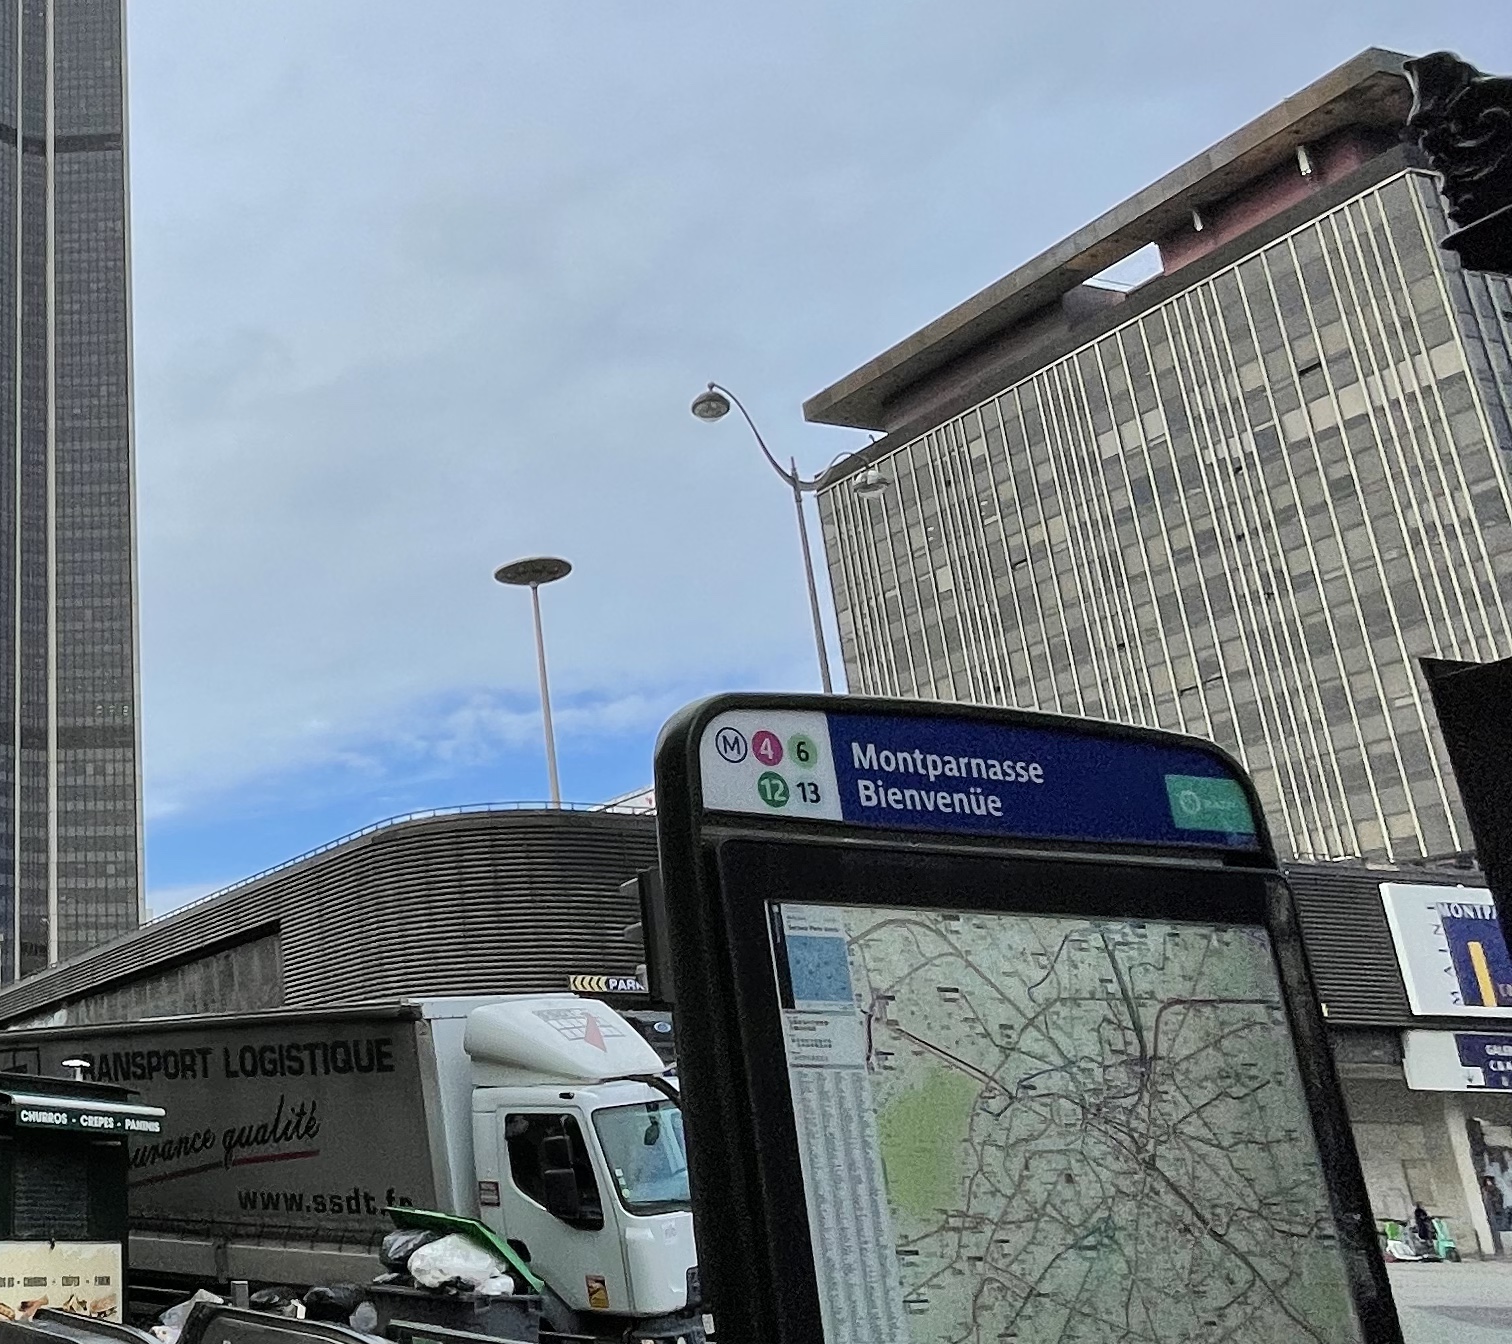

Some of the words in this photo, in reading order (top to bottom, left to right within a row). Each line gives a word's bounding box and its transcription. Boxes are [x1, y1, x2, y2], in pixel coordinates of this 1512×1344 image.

[759, 738, 775, 760] 4
[795, 740, 810, 763] 6
[850, 741, 1045, 785] Montparnasse
[760, 779, 787, 804] 12
[796, 781, 821, 805] 13
[857, 779, 1004, 817] Bienvenüe
[223, 1038, 396, 1078] LOGISTIQUE
[20, 1109, 68, 1125] CHURROS
[79, 1114, 115, 1129] CREPES
[124, 1118, 161, 1133] PANINIS
[128, 1128, 216, 1168] urance
[222, 1094, 321, 1171] qualité
